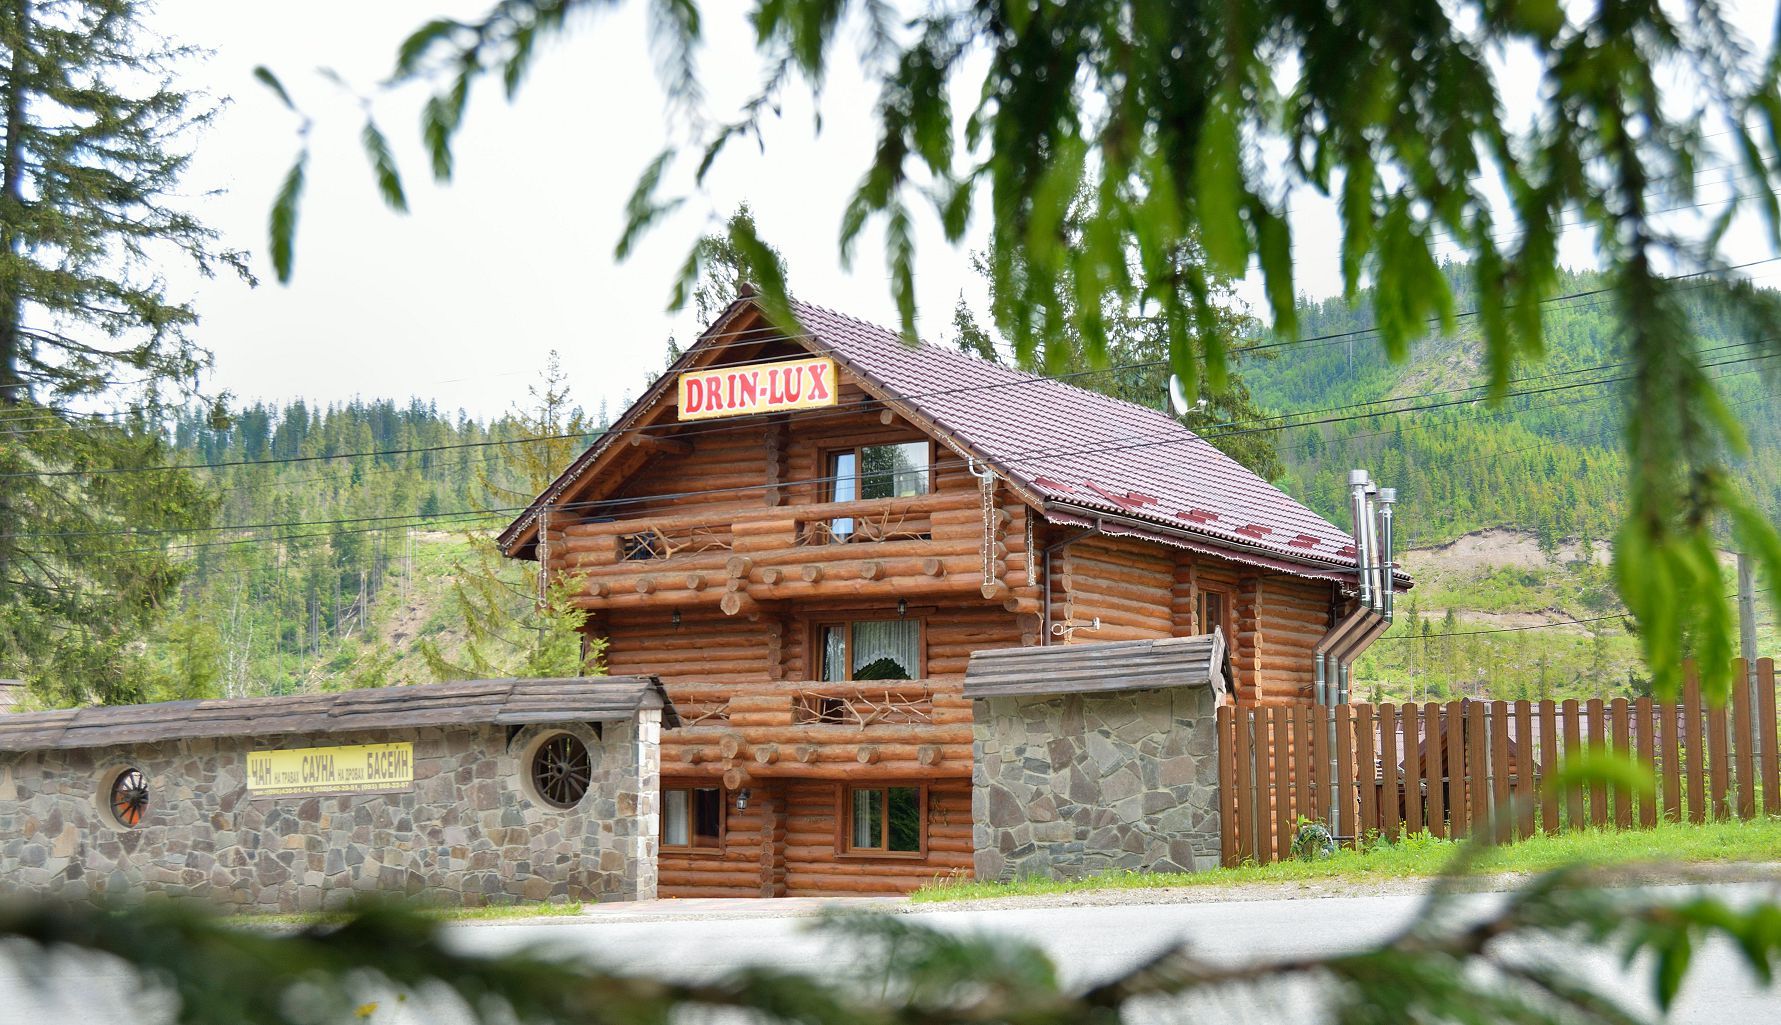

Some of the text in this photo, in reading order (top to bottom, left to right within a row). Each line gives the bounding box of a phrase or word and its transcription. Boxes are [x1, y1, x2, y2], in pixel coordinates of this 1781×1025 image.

[685, 363, 829, 413] DRIN-LUX
[251, 745, 408, 785] ЧАН НА ТРАВАХ САУНА НА ДРОВАХ БАСЕЙН
